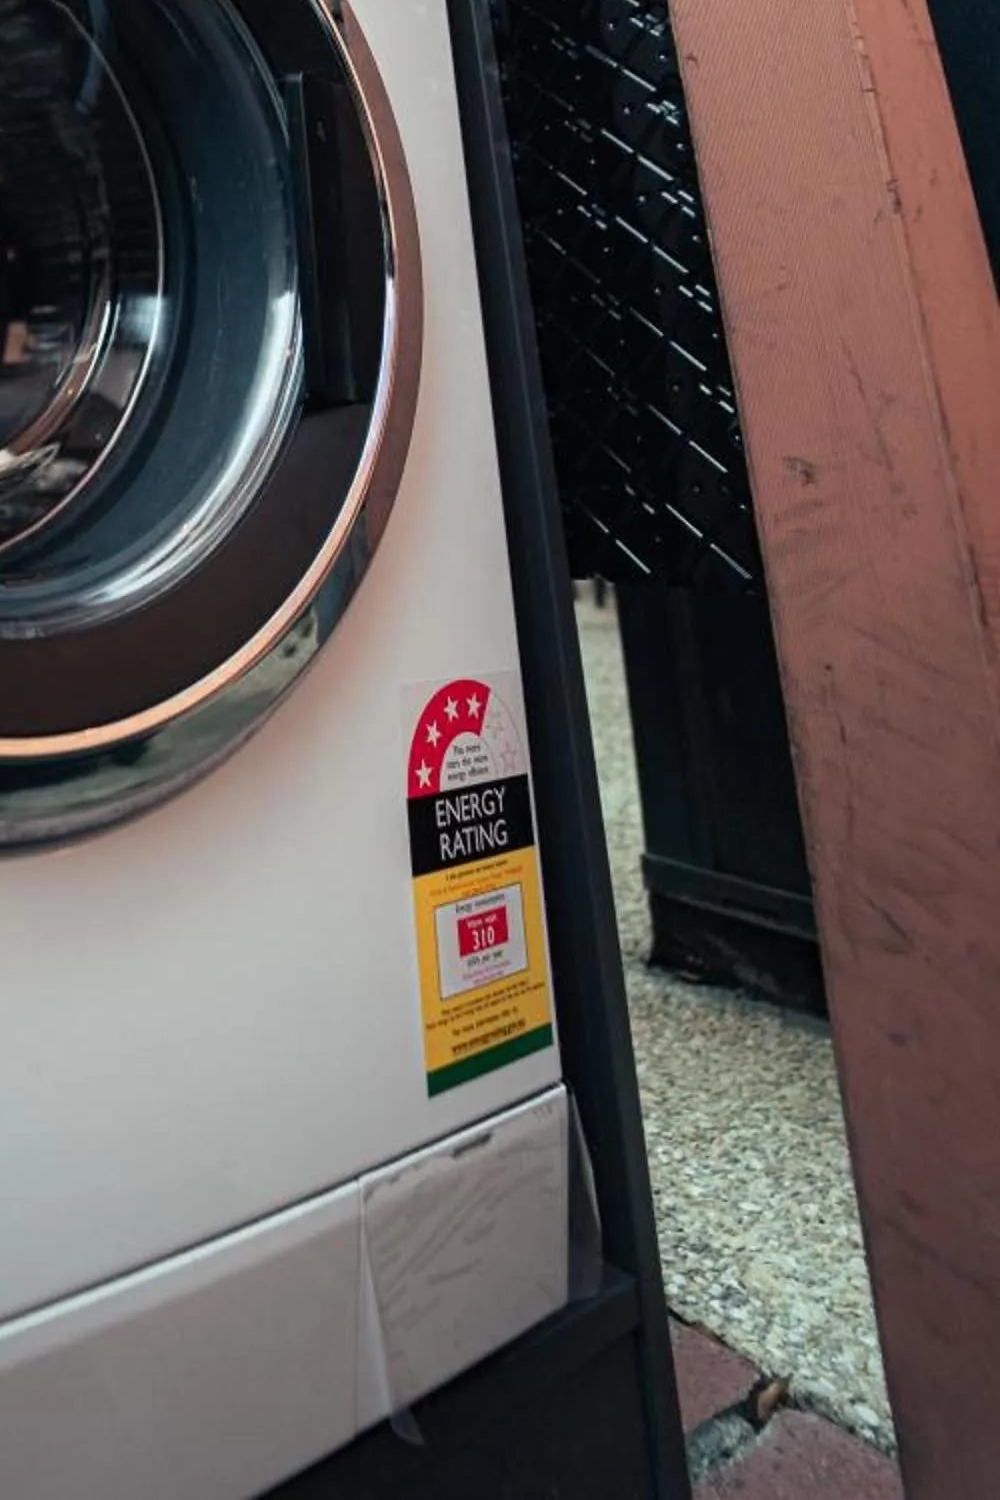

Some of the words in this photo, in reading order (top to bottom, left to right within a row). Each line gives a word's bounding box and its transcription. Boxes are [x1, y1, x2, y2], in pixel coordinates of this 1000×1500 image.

[435, 785, 505, 828] ENERGY
[440, 819, 508, 861] RATING
[472, 925, 495, 951] 310
